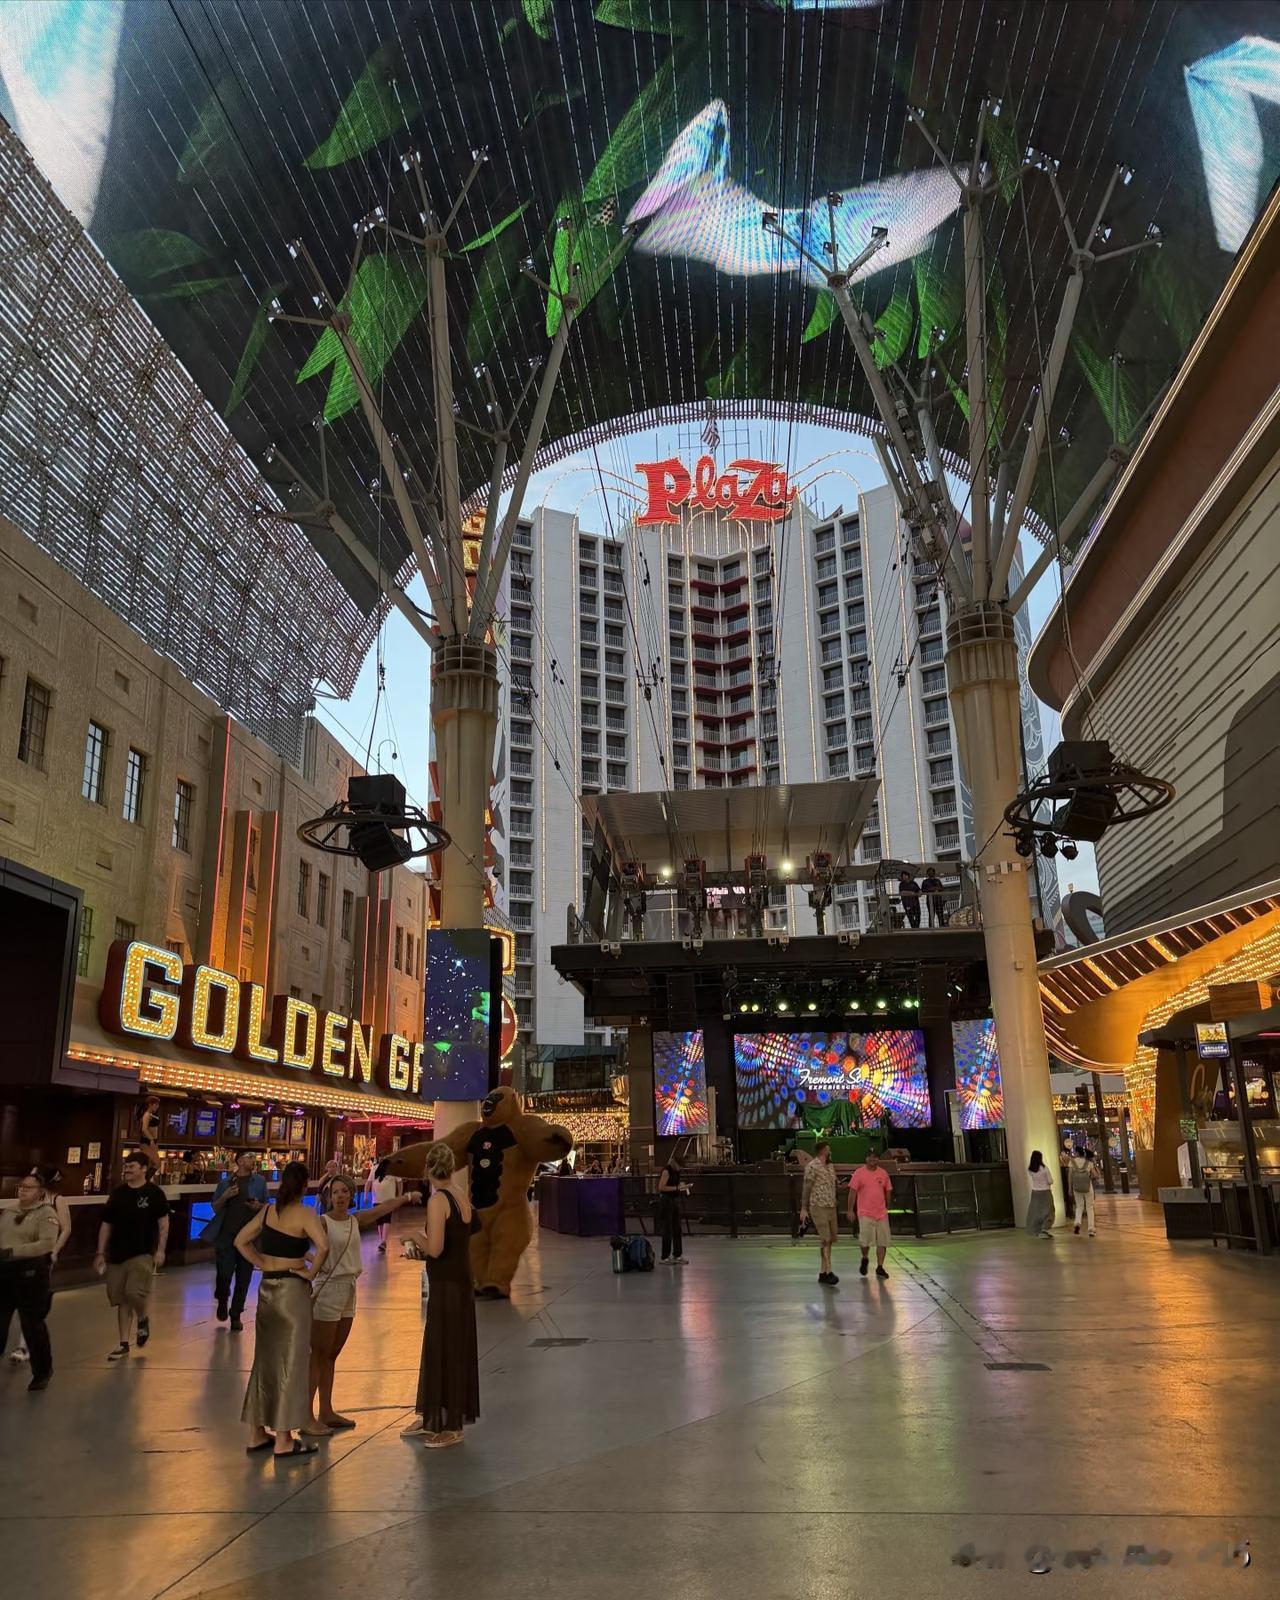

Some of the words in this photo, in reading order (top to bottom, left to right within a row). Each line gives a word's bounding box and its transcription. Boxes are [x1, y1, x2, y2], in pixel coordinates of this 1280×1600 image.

[635, 455, 797, 527] Plaza
[120, 941, 373, 1083] GOLDEN
[799, 1068, 845, 1085] Fremont
